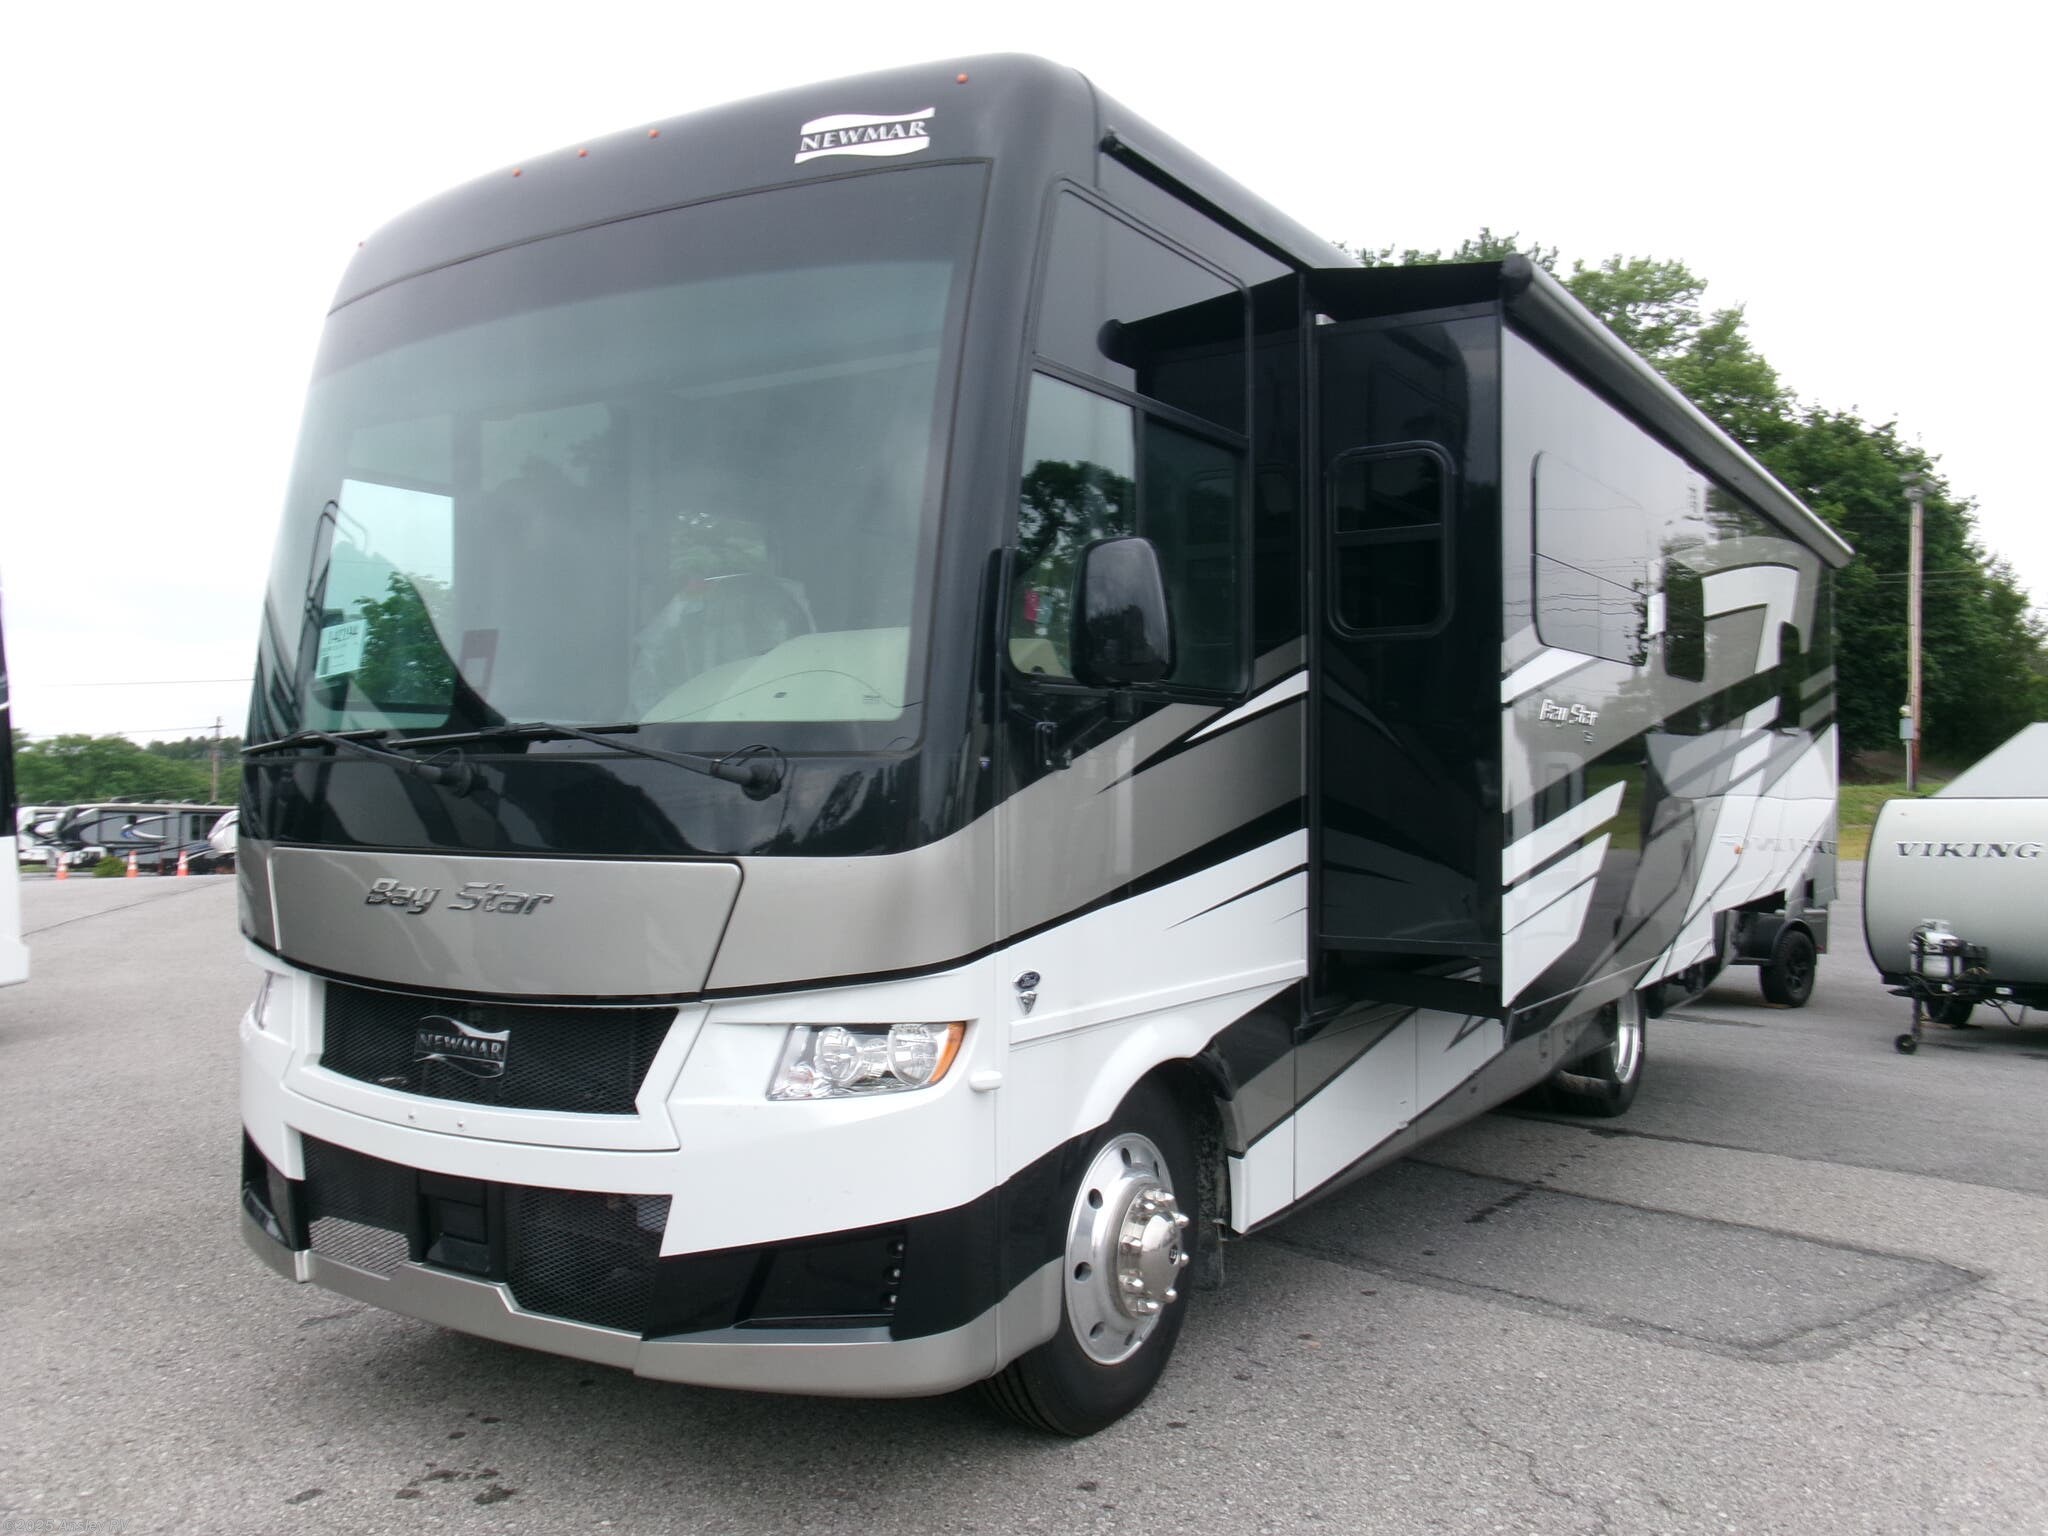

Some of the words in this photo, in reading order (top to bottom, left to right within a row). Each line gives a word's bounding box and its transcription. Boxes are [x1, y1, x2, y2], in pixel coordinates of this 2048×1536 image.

[800, 120, 928, 152] NEWMAR
[1896, 841, 2042, 859] VIKING
[365, 876, 441, 915] Bay
[447, 881, 555, 915] Star
[419, 1033, 504, 1060] NEWMAR
